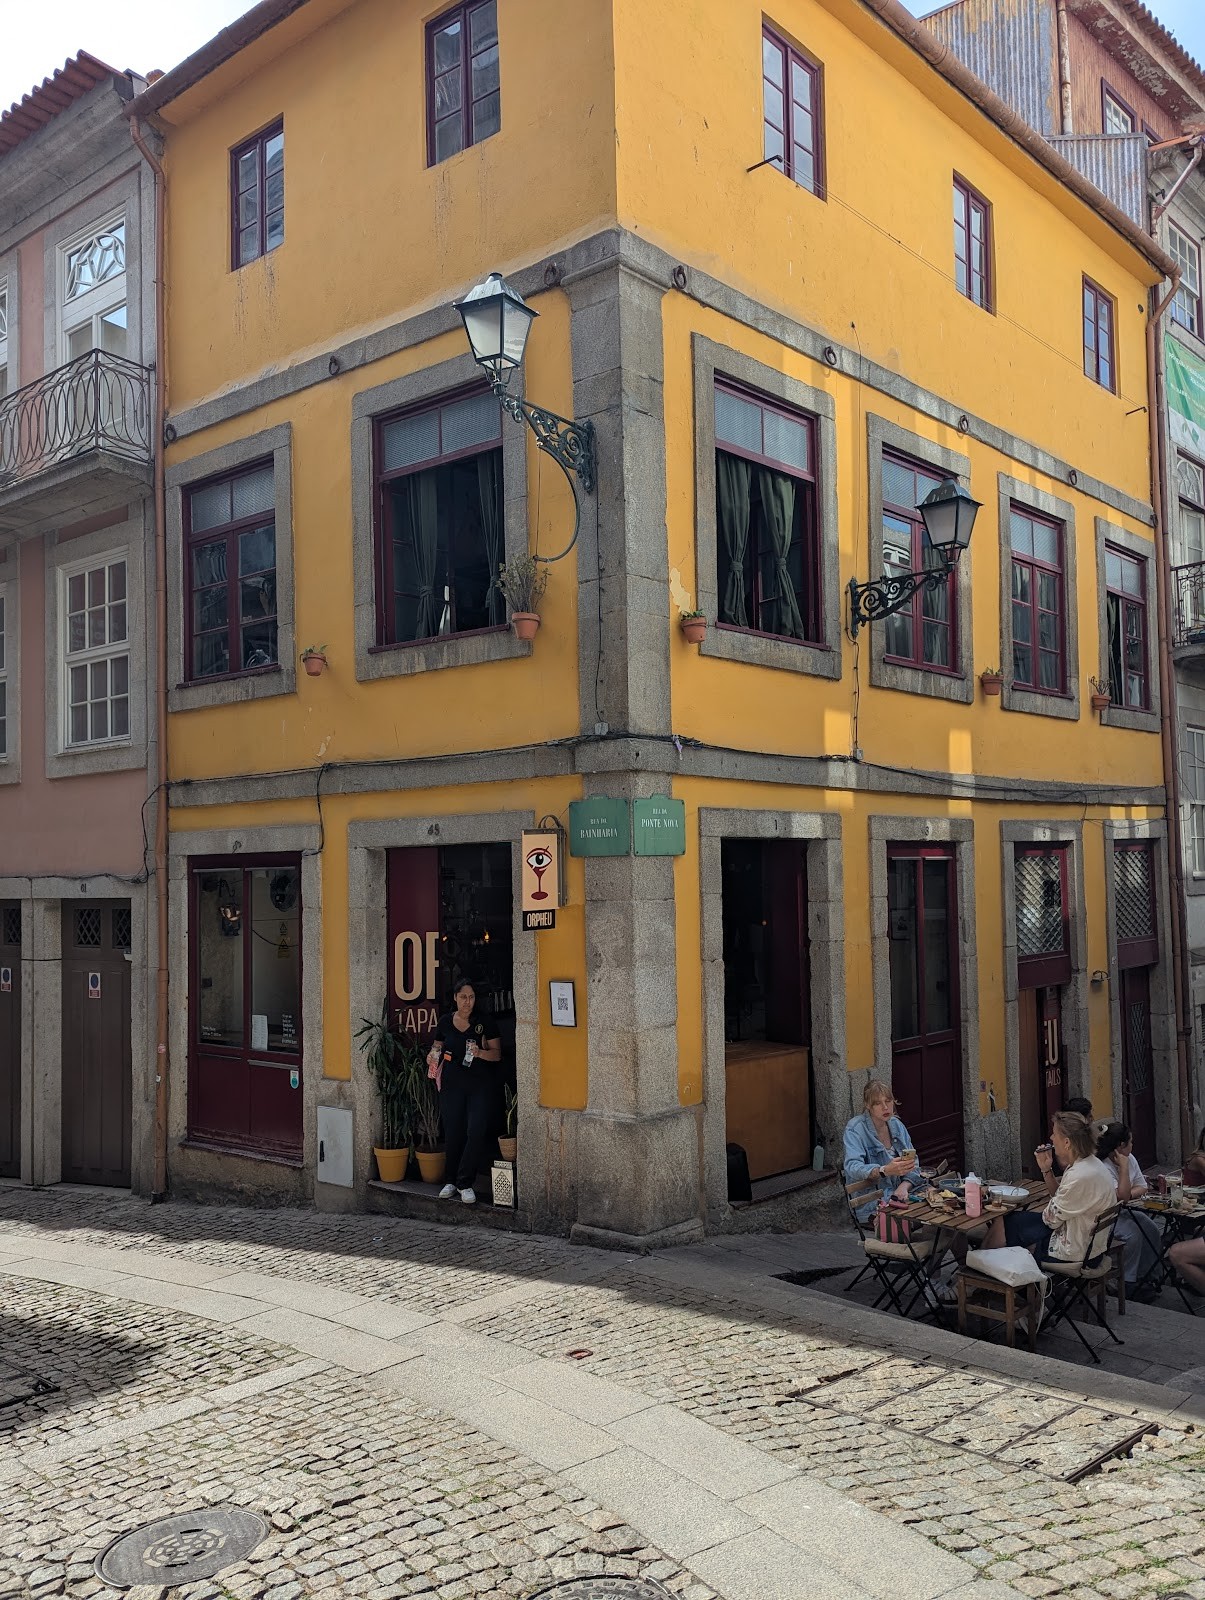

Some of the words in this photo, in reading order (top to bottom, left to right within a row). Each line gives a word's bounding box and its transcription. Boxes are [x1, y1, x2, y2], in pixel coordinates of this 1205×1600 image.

[641, 818, 661, 828] PONTE
[663, 818, 679, 828] NOVA
[580, 828, 618, 839] BAINHARIA
[526, 911, 553, 928] ORPHEU
[1043, 1018, 1059, 1066] U
